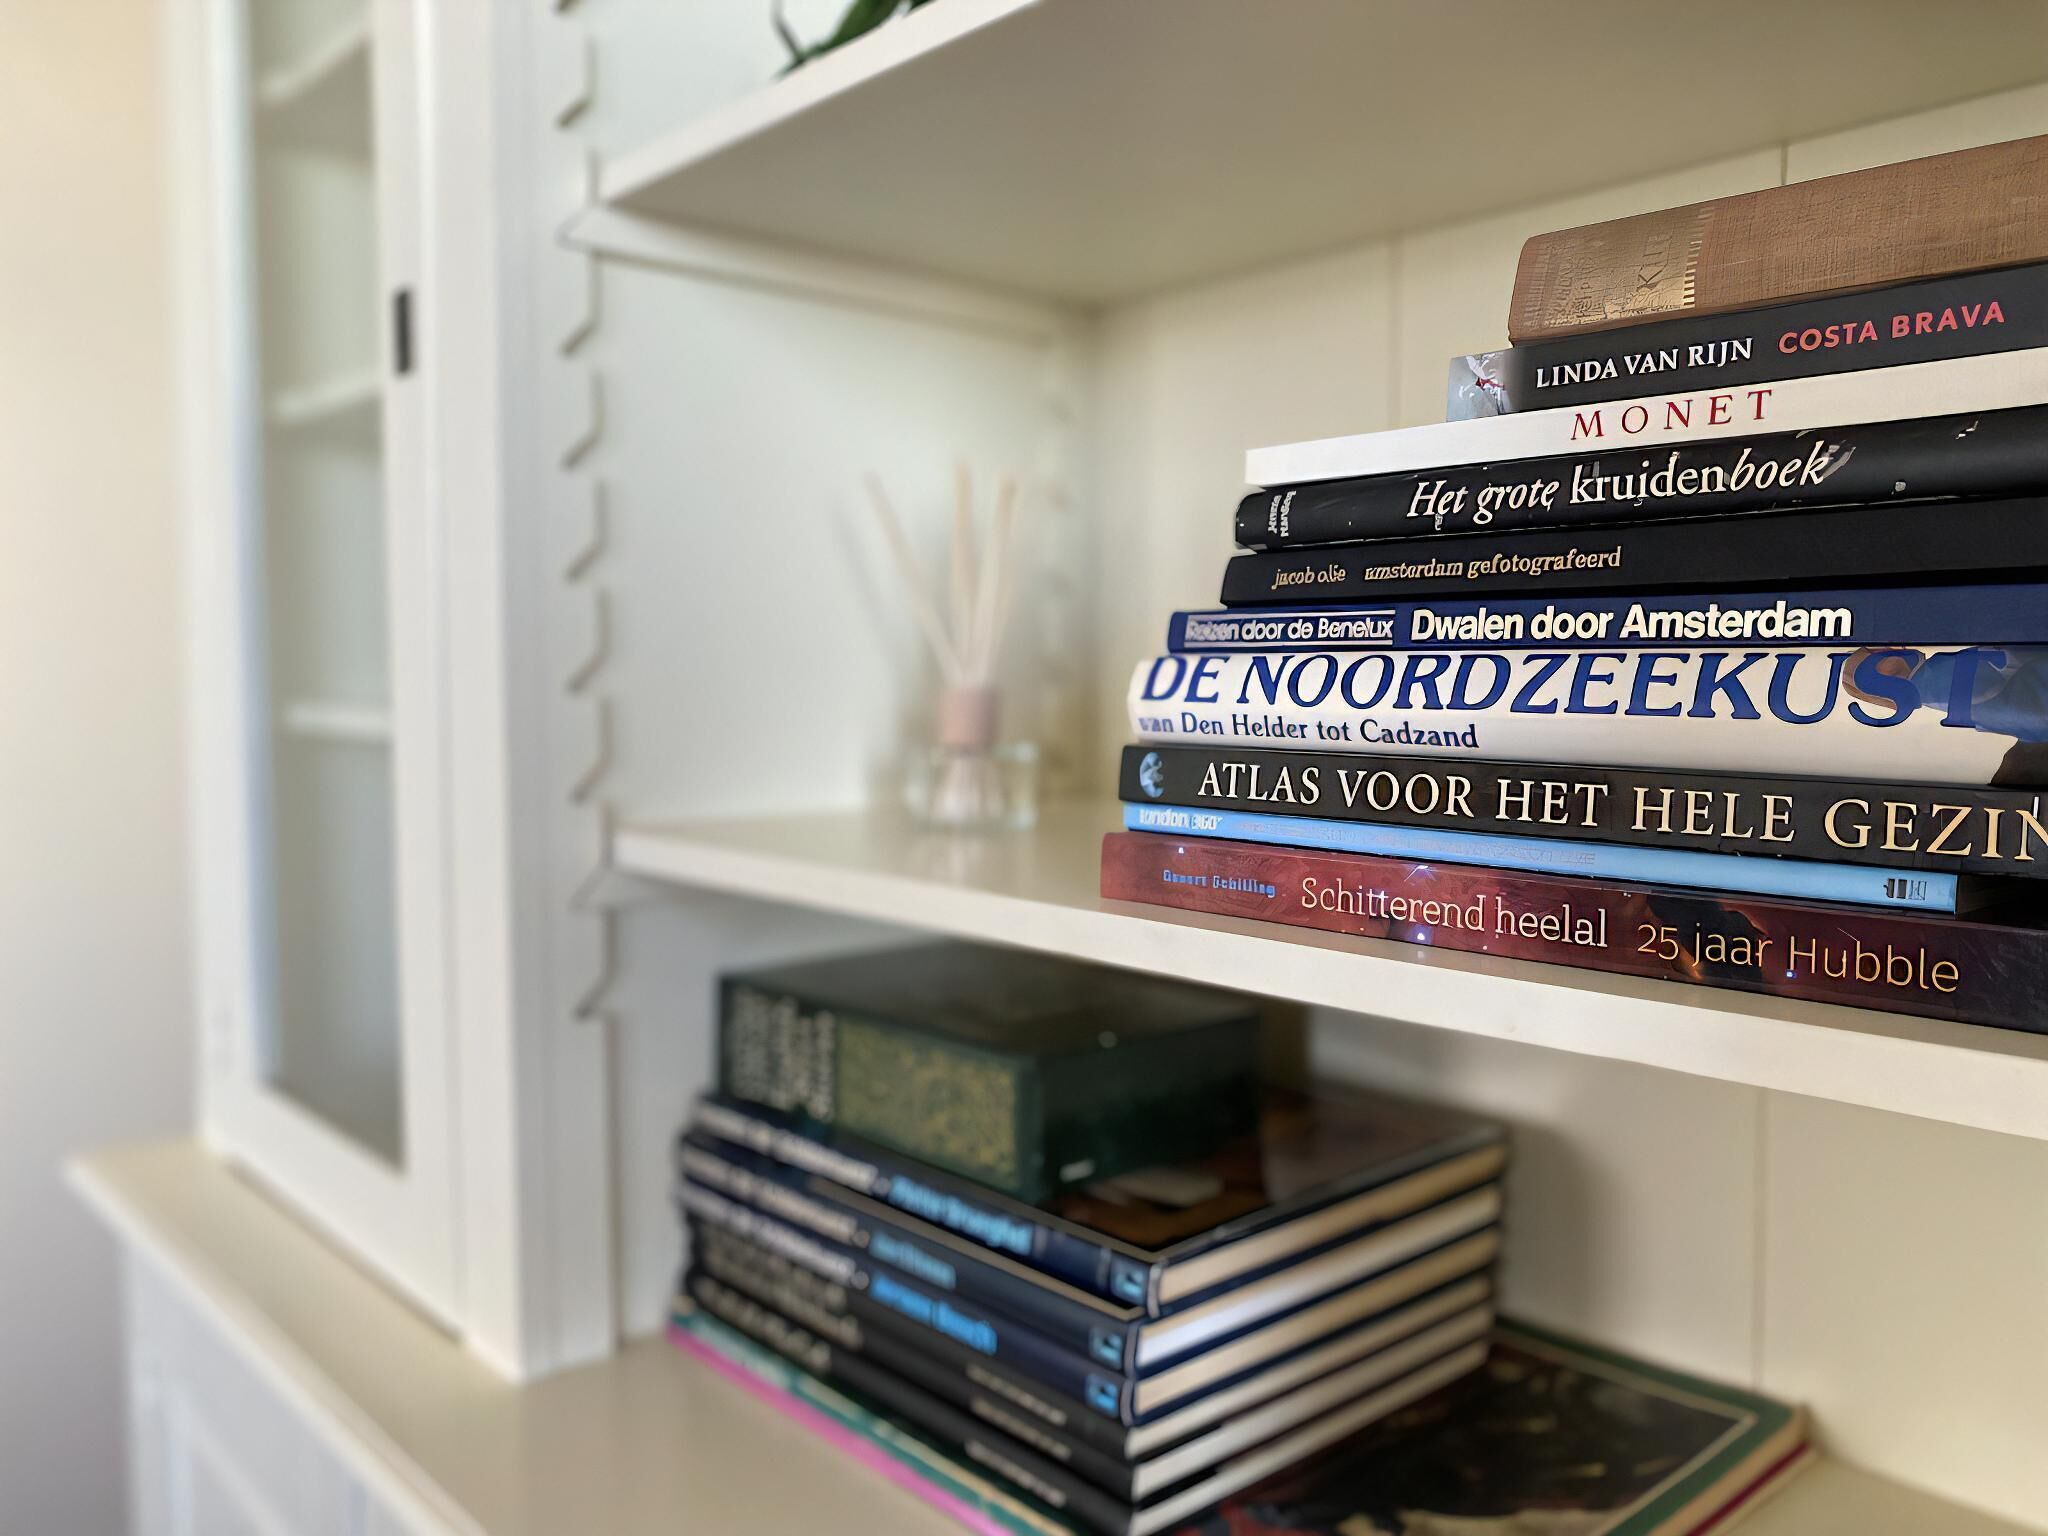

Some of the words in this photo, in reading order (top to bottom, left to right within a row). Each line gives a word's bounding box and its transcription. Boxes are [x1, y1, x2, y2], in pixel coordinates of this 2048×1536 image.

[1777, 319, 1879, 356] COSTA
[1891, 300, 2006, 341] BRAVA
[1535, 356, 1619, 389] LINDA
[1624, 348, 1680, 377] VAN
[1687, 337, 1753, 369] RIJN
[1570, 389, 1773, 442] MONET
[1407, 481, 1469, 519] Het
[1472, 478, 1559, 526] grote
[1569, 439, 1831, 505] kruidenboek
[1271, 566, 1315, 590] jacob
[1467, 546, 1622, 579] gefotografeerd
[1241, 619, 1284, 641] door
[1287, 618, 1313, 640] de
[1318, 616, 1394, 639] Benelux
[1411, 608, 1525, 641] Dwalen
[1531, 604, 1613, 641] door
[1619, 600, 1853, 639] Amsterdam
[1140, 654, 1231, 703] DE
[1238, 648, 2007, 728] NOORDZEEKUST
[1181, 711, 1225, 736] Den
[1232, 713, 1309, 741] Helder
[1315, 719, 1352, 743] tot
[1358, 717, 1480, 749] Cadzand
[1197, 761, 1320, 805] ATLAS
[1336, 769, 1475, 819] VOOR
[1496, 778, 1609, 829] HET
[1630, 786, 1797, 843] HELE
[1301, 876, 1486, 932] Schitterend
[1494, 896, 1609, 949] heelal
[1636, 923, 1680, 961] 25
[1691, 921, 1774, 969] jaar
[1790, 934, 1960, 993] Hubble
